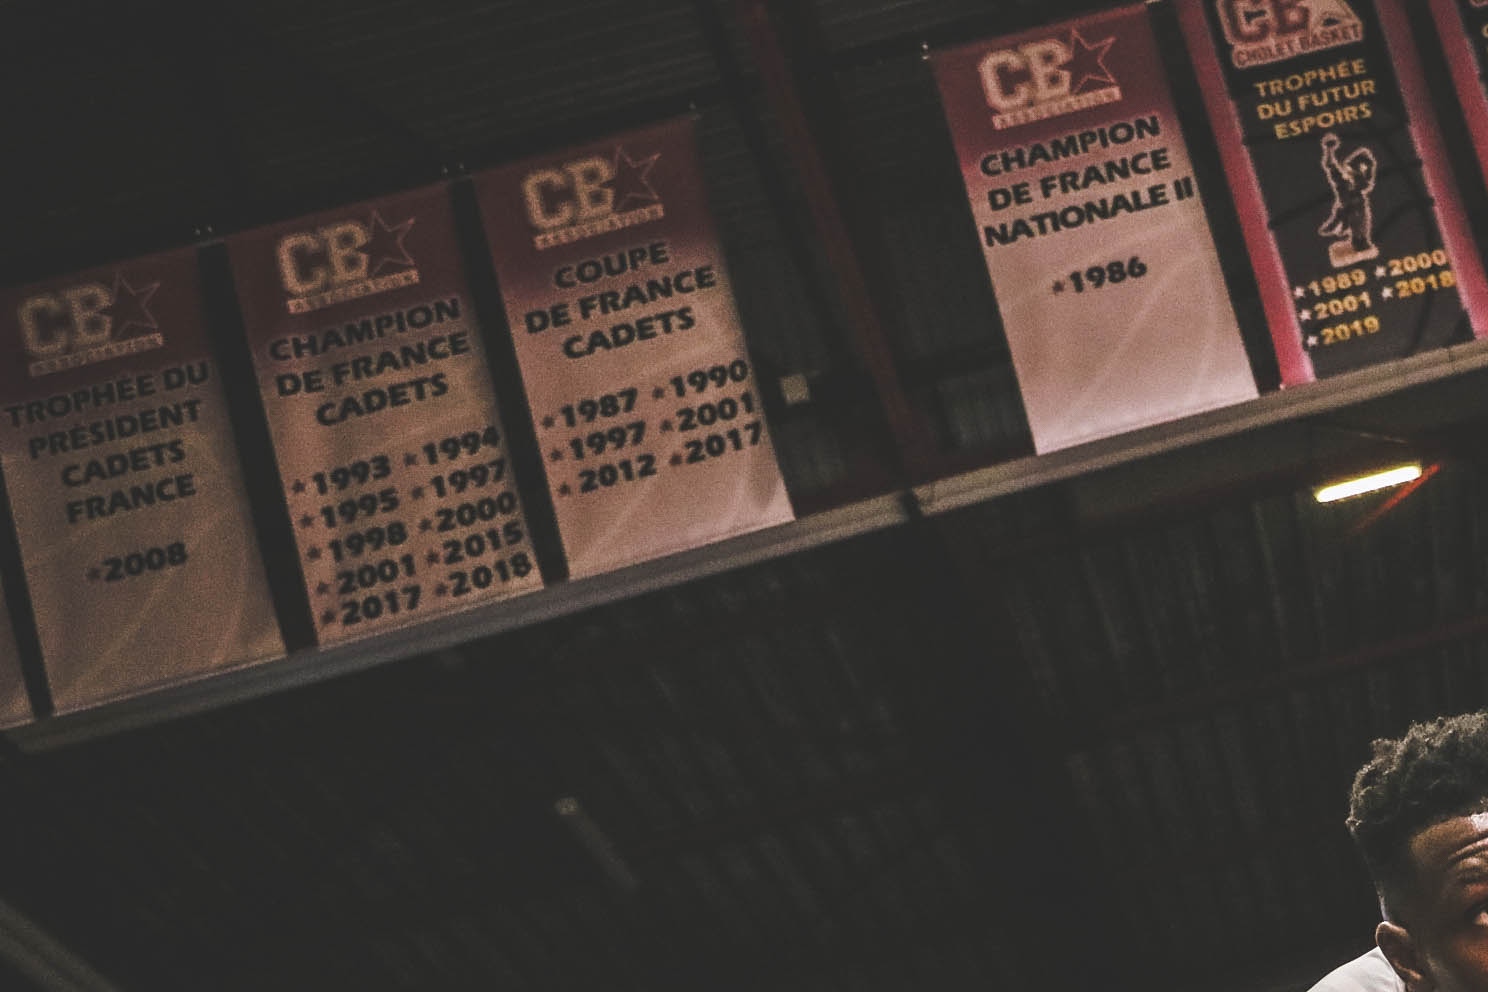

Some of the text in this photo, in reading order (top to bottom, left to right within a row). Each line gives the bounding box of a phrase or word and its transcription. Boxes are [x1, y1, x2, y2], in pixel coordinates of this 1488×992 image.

[1254, 58, 1366, 97] TROPHÉE
[1257, 79, 1376, 120] DU FUTUR
[980, 115, 1161, 177] CHAMPION
[1274, 102, 1373, 140] ESPOIRS
[987, 148, 1171, 212] DE FRANCE
[983, 176, 1195, 247] NATIONALE II
[554, 242, 669, 289] COUPE
[1070, 256, 1148, 293] 1986
[1308, 250, 1448, 298] 1989 2000
[525, 265, 716, 334] DE FRANCE
[1314, 270, 1457, 320] 2001 2018
[269, 299, 460, 361] CHAMPION
[563, 306, 695, 359] CADETS
[1321, 315, 1380, 345] 2019
[164, 361, 209, 392] DU
[276, 331, 470, 397] DE FRANCE
[316, 372, 448, 427] CADETS
[561, 359, 748, 428] 1987 1990
[570, 391, 754, 460] 1997 2001
[62, 439, 186, 488] CADETS
[313, 425, 500, 495] 1993 1994
[578, 420, 762, 494] 2012 2017
[67, 473, 196, 524] FRANCE
[321, 457, 505, 529] 1995 1997
[329, 491, 516, 562] 1998 2000
[104, 542, 188, 582] 2008
[337, 520, 524, 594] 2001 2015
[342, 551, 532, 626] 2017 2018
